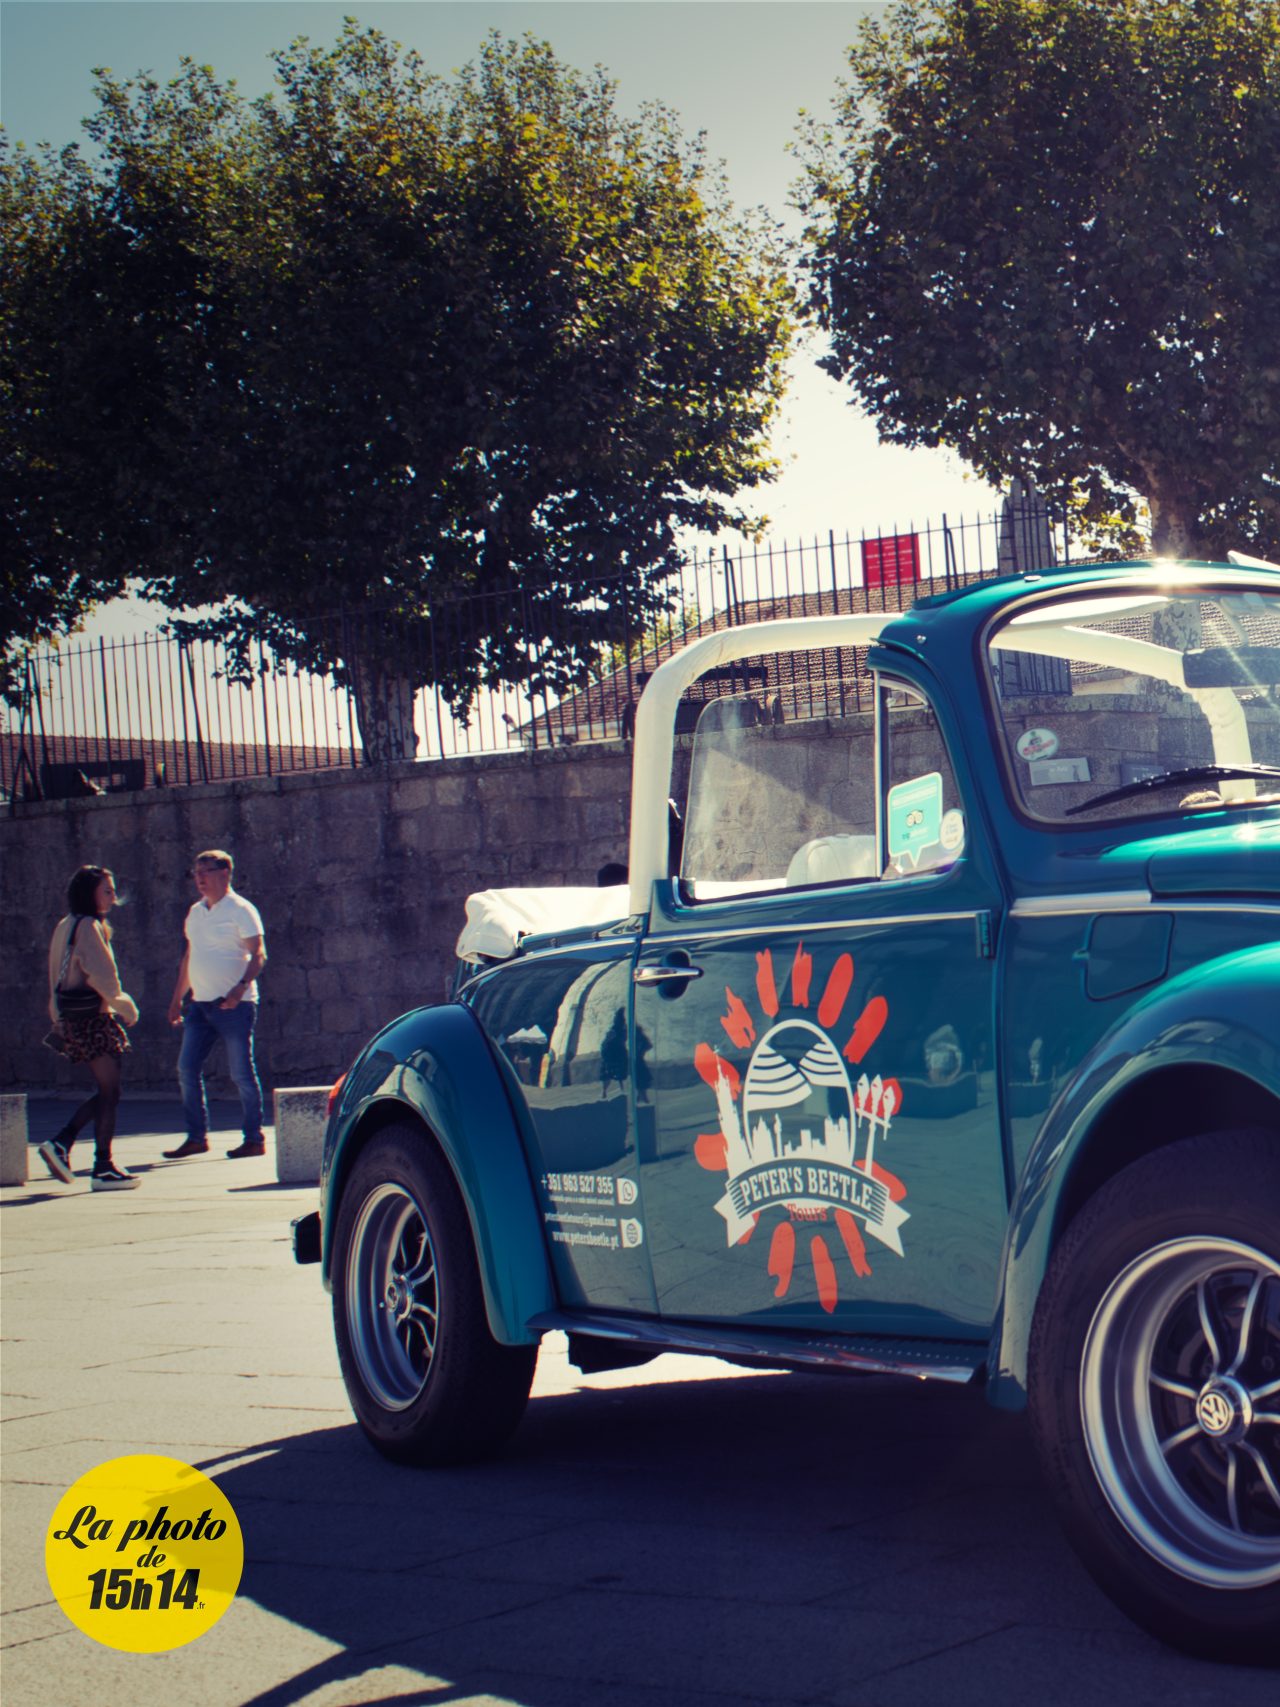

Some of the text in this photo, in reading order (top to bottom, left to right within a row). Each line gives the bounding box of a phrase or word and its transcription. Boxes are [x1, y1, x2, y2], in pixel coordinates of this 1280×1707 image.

[562, 1175, 578, 1192] 963
[579, 1176, 595, 1193] 527
[596, 1177, 614, 1195] 355
[739, 1166, 874, 1211] PETER'S BEETLE
[788, 1203, 827, 1221] Tours
